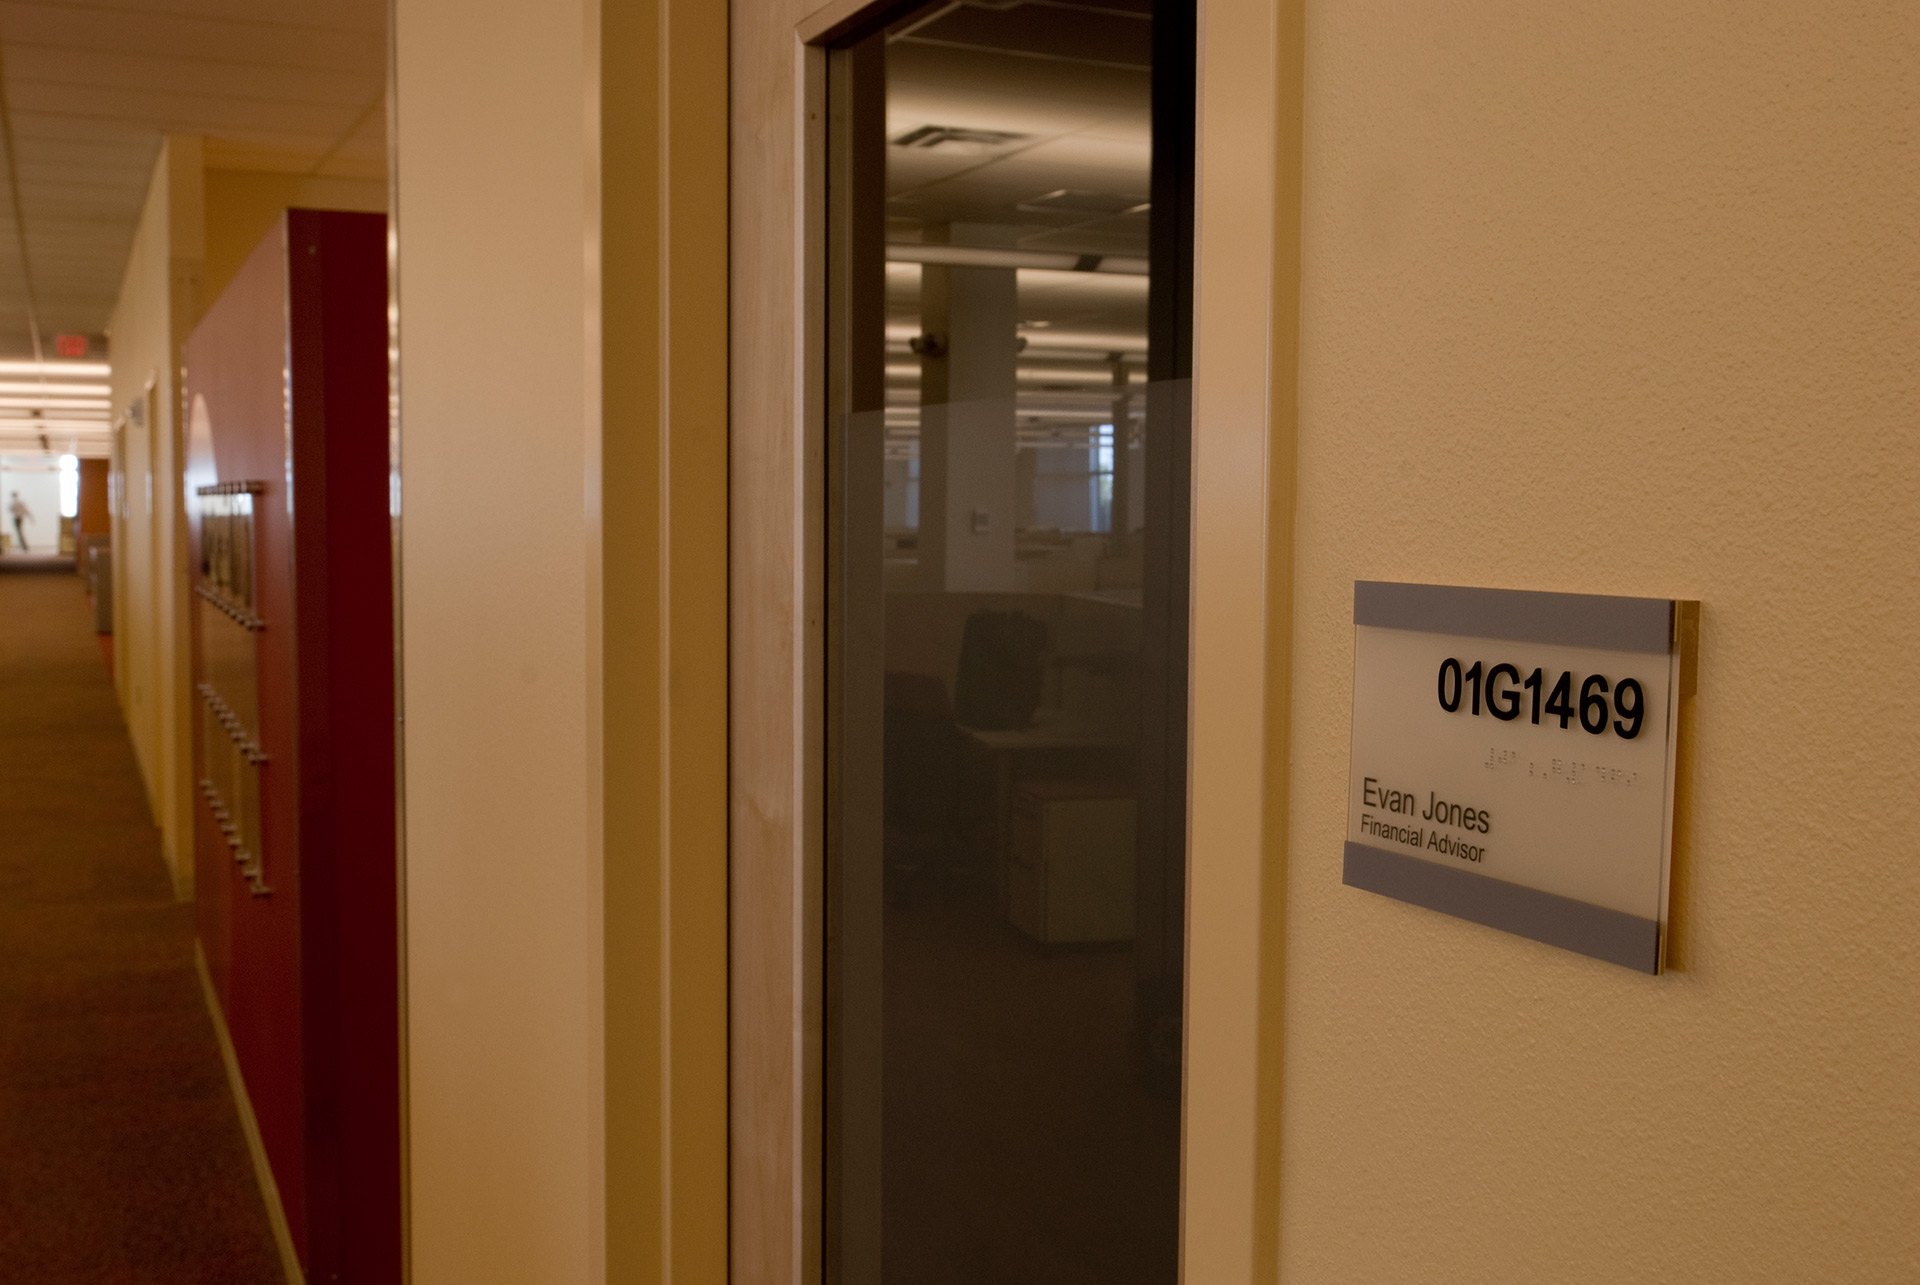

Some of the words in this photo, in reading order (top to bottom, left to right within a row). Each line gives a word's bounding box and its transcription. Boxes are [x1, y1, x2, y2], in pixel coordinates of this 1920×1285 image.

[1438, 658, 1645, 740] 01G1469
[1363, 777, 1415, 817] Evan
[1422, 791, 1490, 834] Jones
[1361, 814, 1423, 848] Financial
[1427, 830, 1485, 863] Advisor
